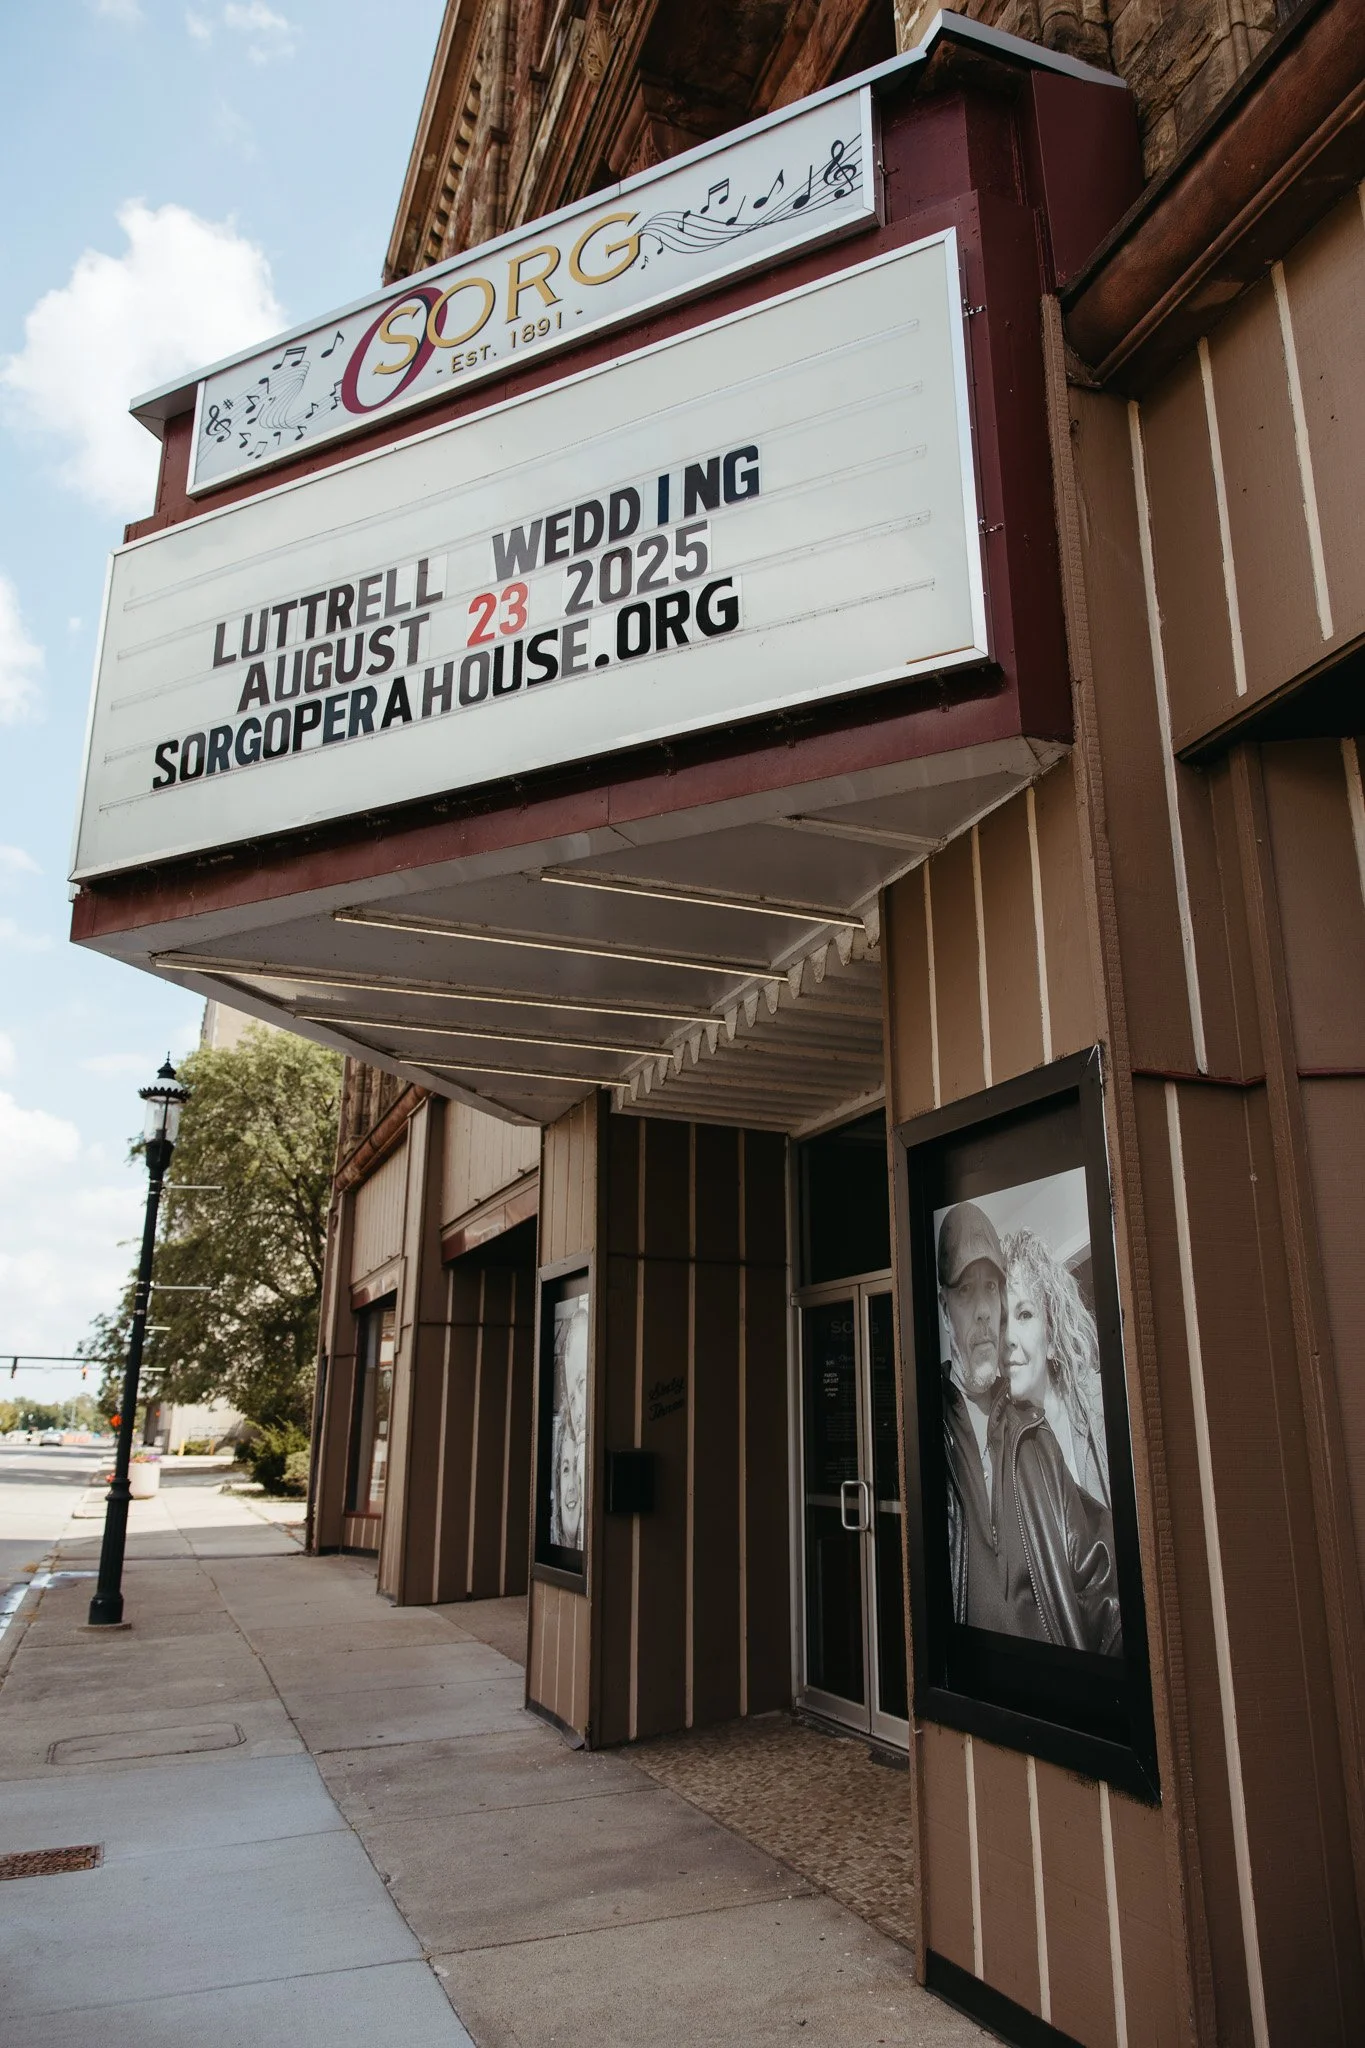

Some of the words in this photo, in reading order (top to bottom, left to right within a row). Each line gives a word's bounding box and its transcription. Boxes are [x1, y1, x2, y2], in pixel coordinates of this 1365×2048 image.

[372, 211, 641, 377] SORG
[451, 344, 498, 374] EST.
[509, 311, 562, 348] 1891
[213, 557, 444, 669] LUTTRELL
[492, 444, 760, 582] WEDDING
[236, 612, 431, 713] AUGUST
[467, 582, 529, 647] 23
[564, 520, 710, 616] 2025
[151, 576, 740, 790] SORGOPERAHOUSE.ORG
